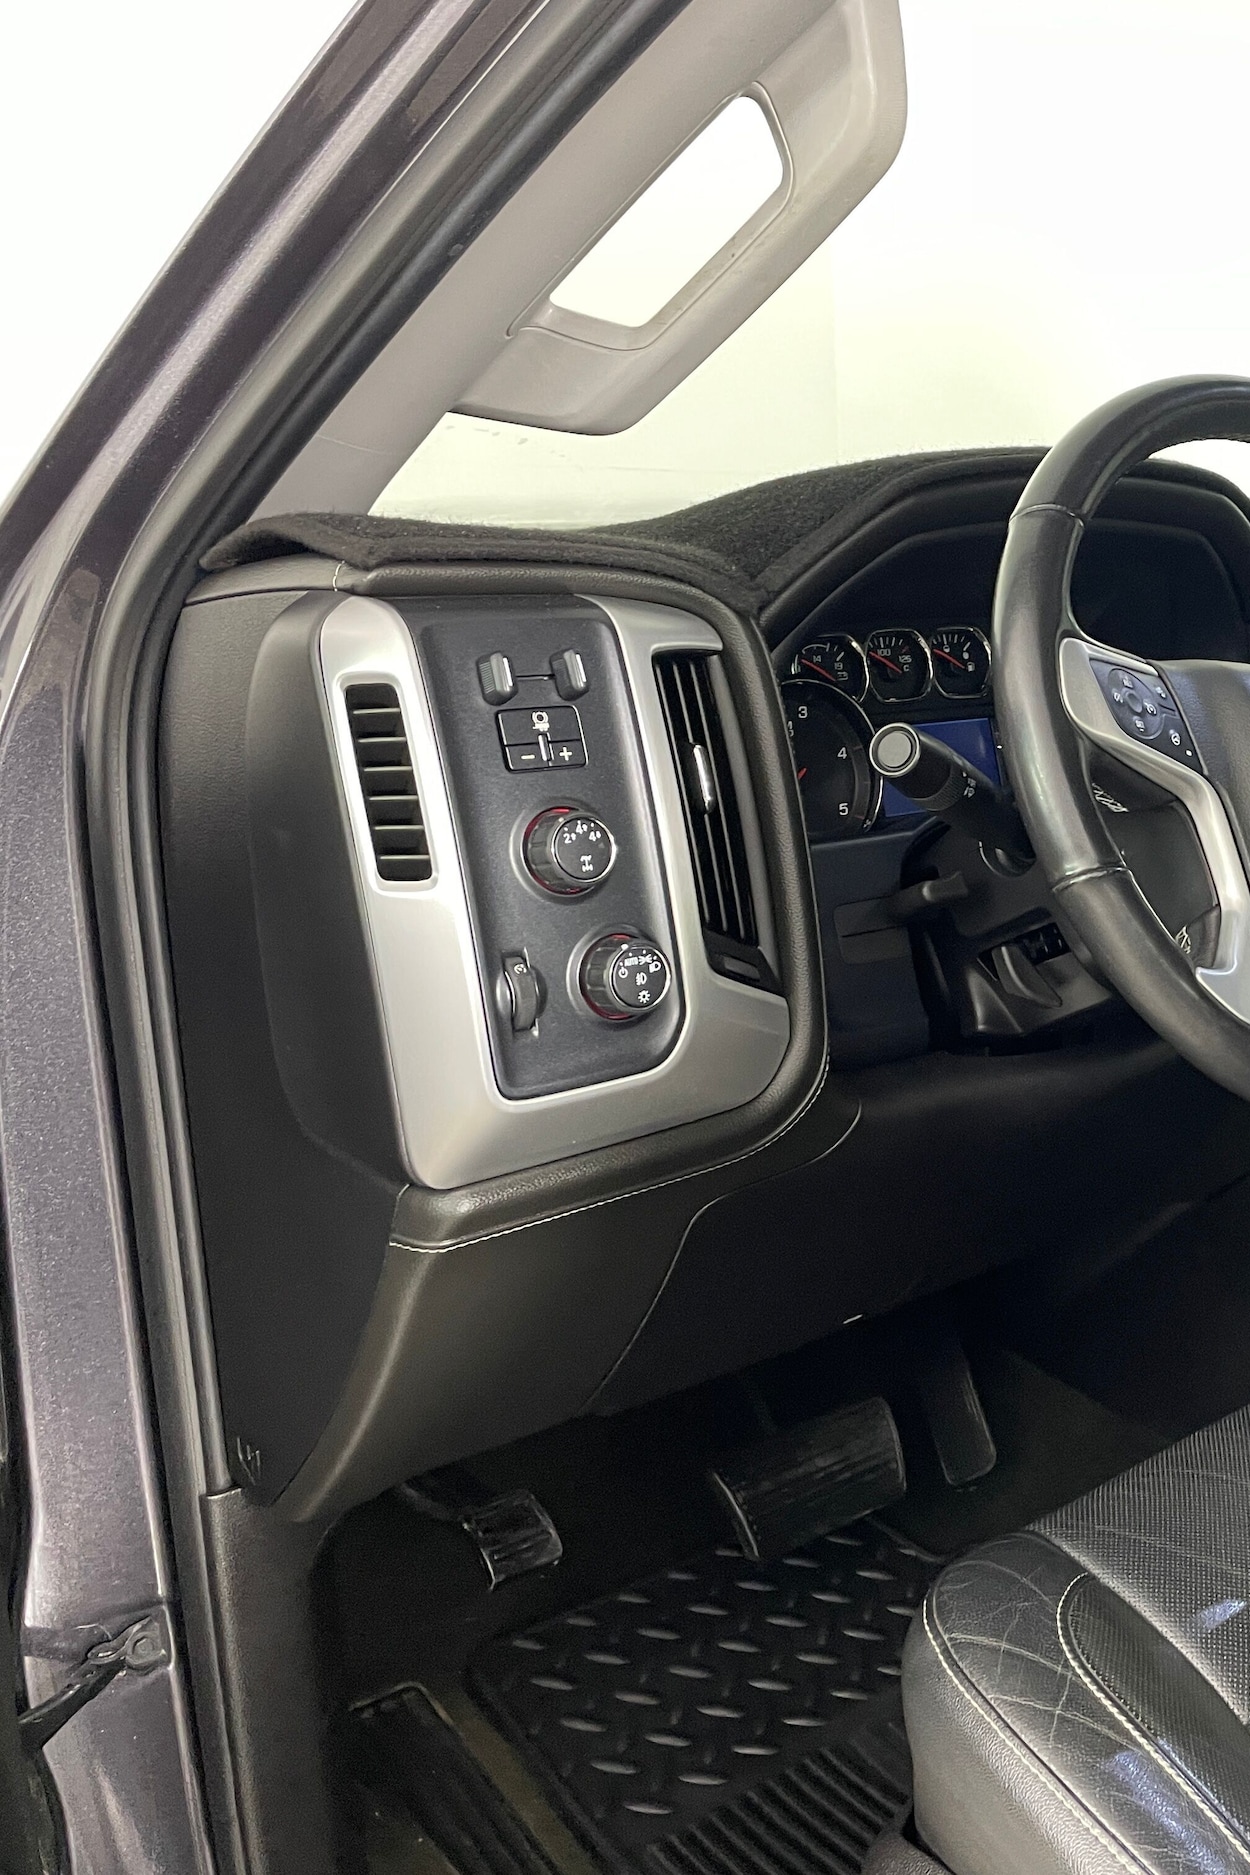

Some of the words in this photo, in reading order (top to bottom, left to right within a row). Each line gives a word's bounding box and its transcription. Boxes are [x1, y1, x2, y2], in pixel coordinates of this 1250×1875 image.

[877, 648, 891, 656] 100
[899, 655, 912, 663] 125
[798, 705, 808, 719] 3
[837, 747, 847, 759] 4
[839, 803, 849, 816] 5
